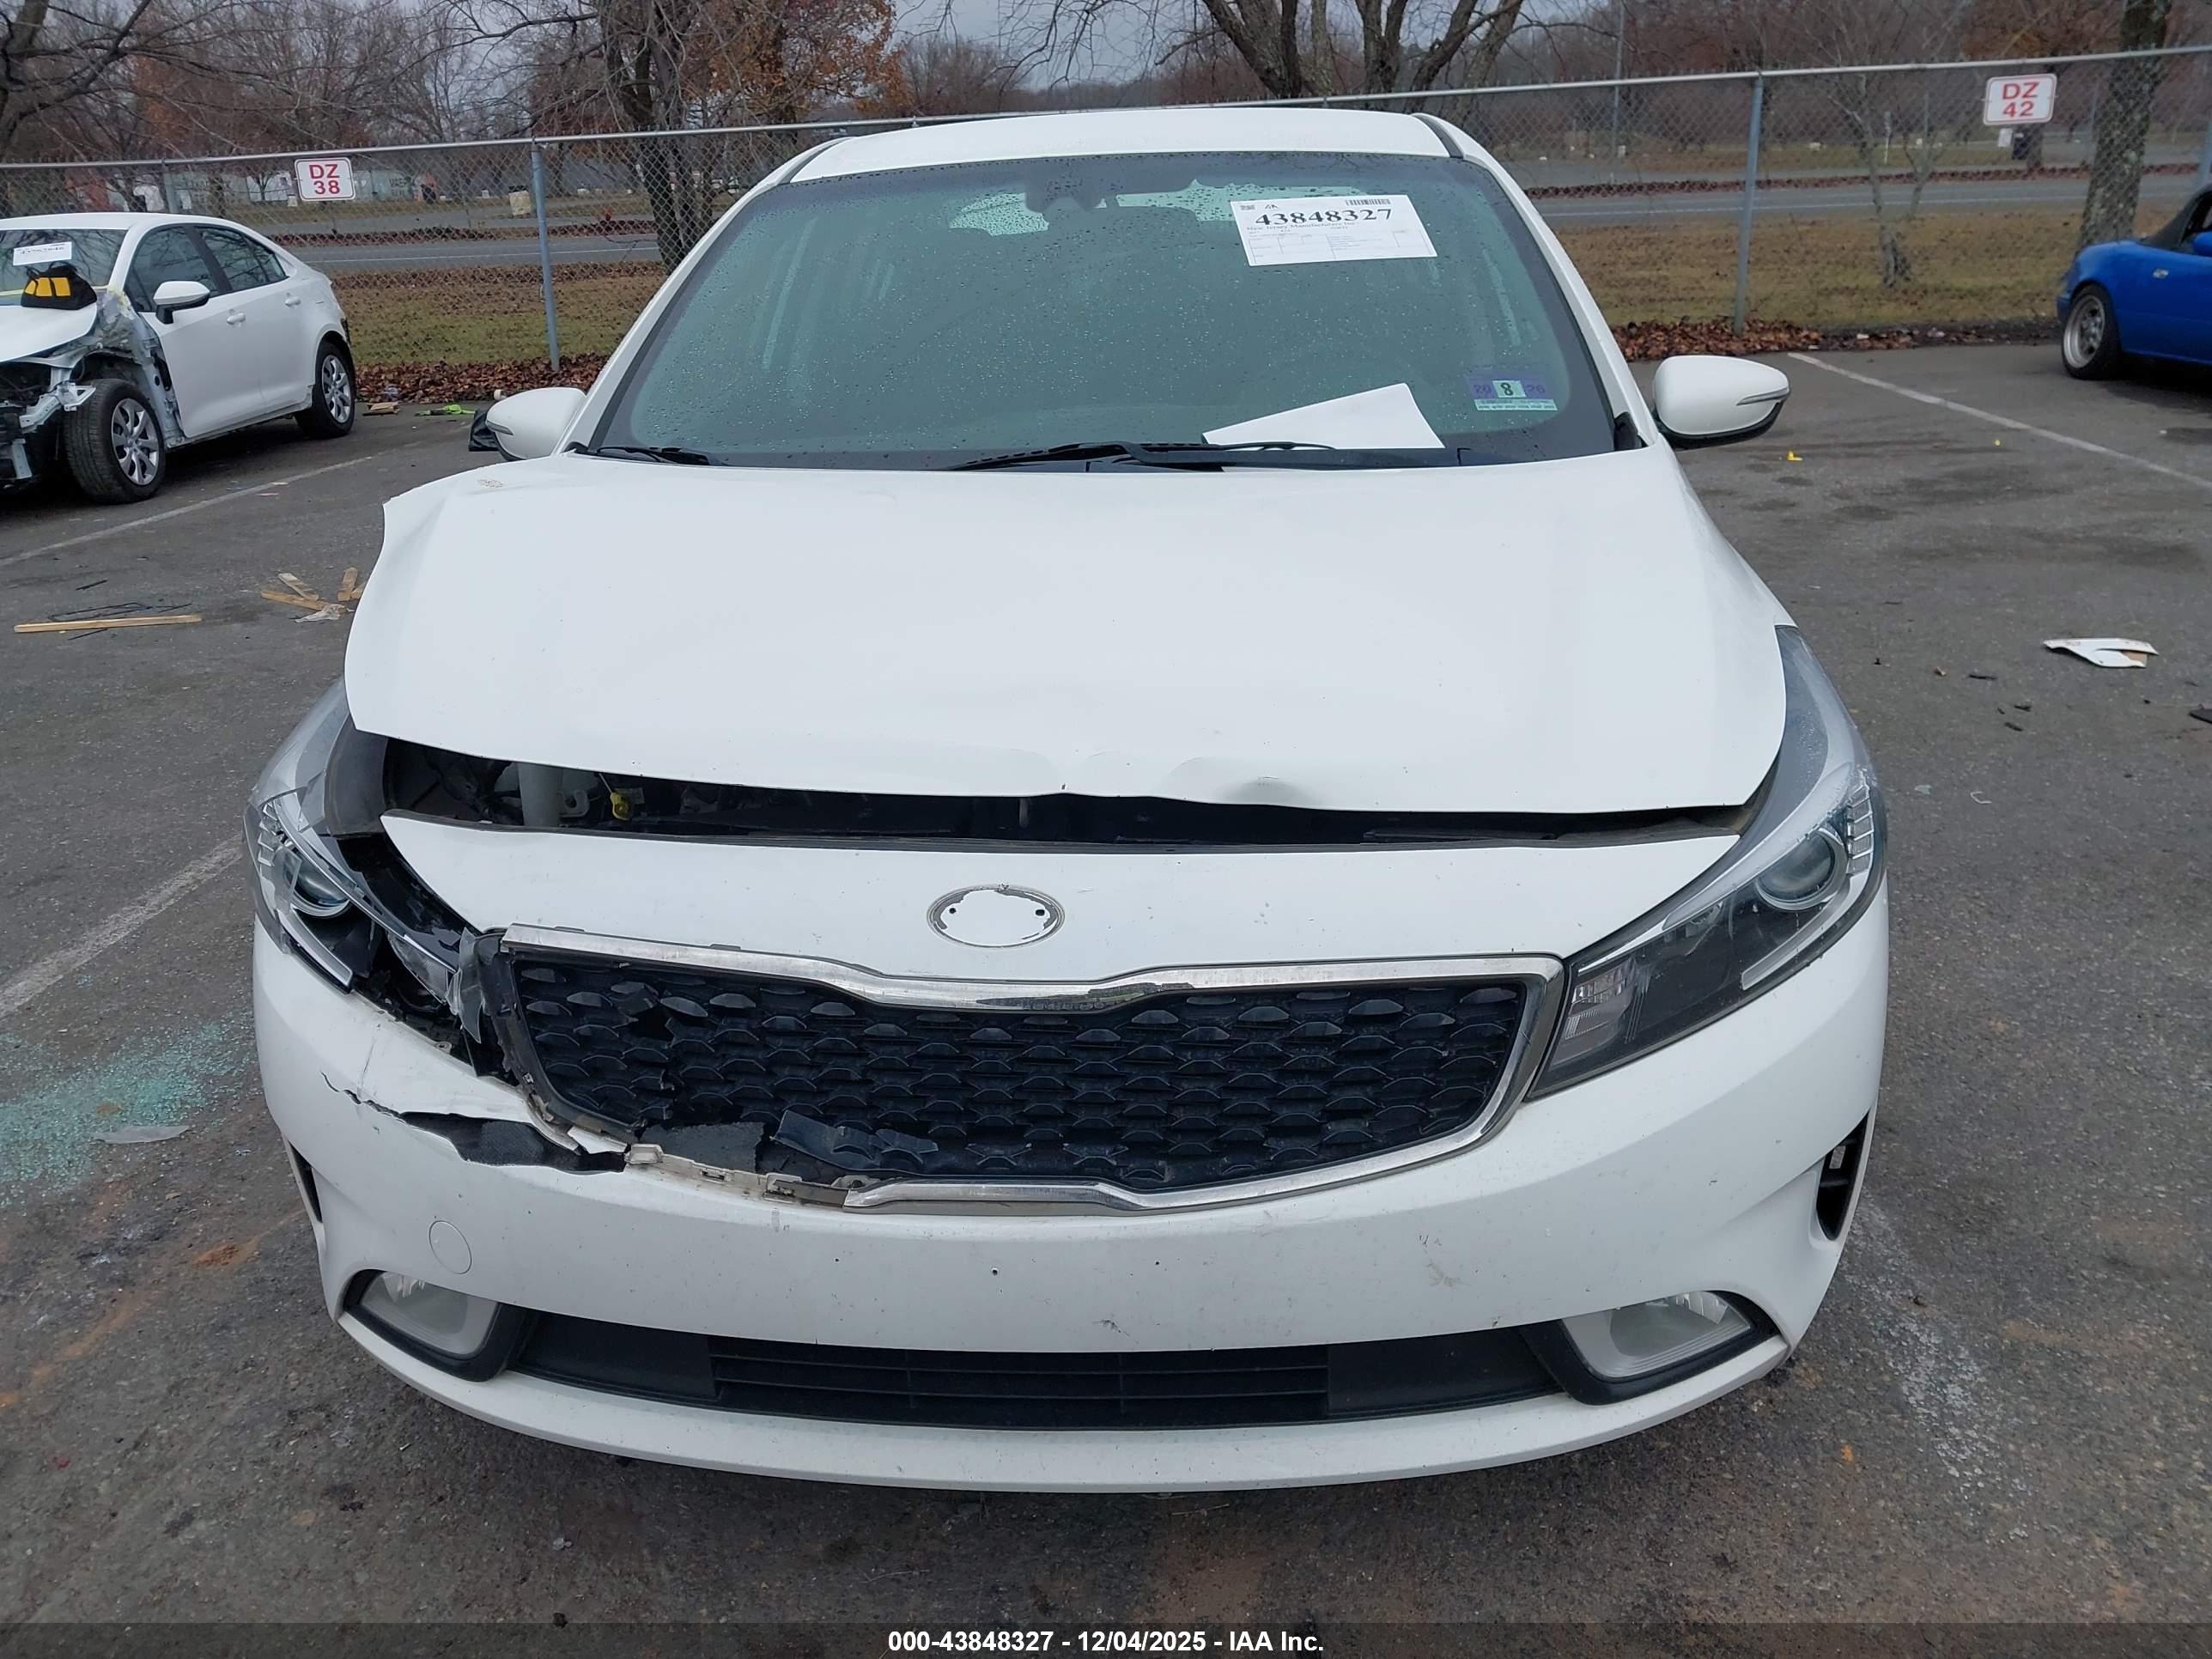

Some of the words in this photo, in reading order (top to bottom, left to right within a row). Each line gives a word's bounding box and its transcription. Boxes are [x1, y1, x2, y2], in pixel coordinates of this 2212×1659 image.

[2002, 82, 2039, 100] DZ
[2002, 100, 2034, 117] 42
[309, 164, 340, 179] DZ
[313, 180, 340, 194] 38
[1255, 209, 1391, 225] 43848327
[1499, 381, 1514, 396] 8
